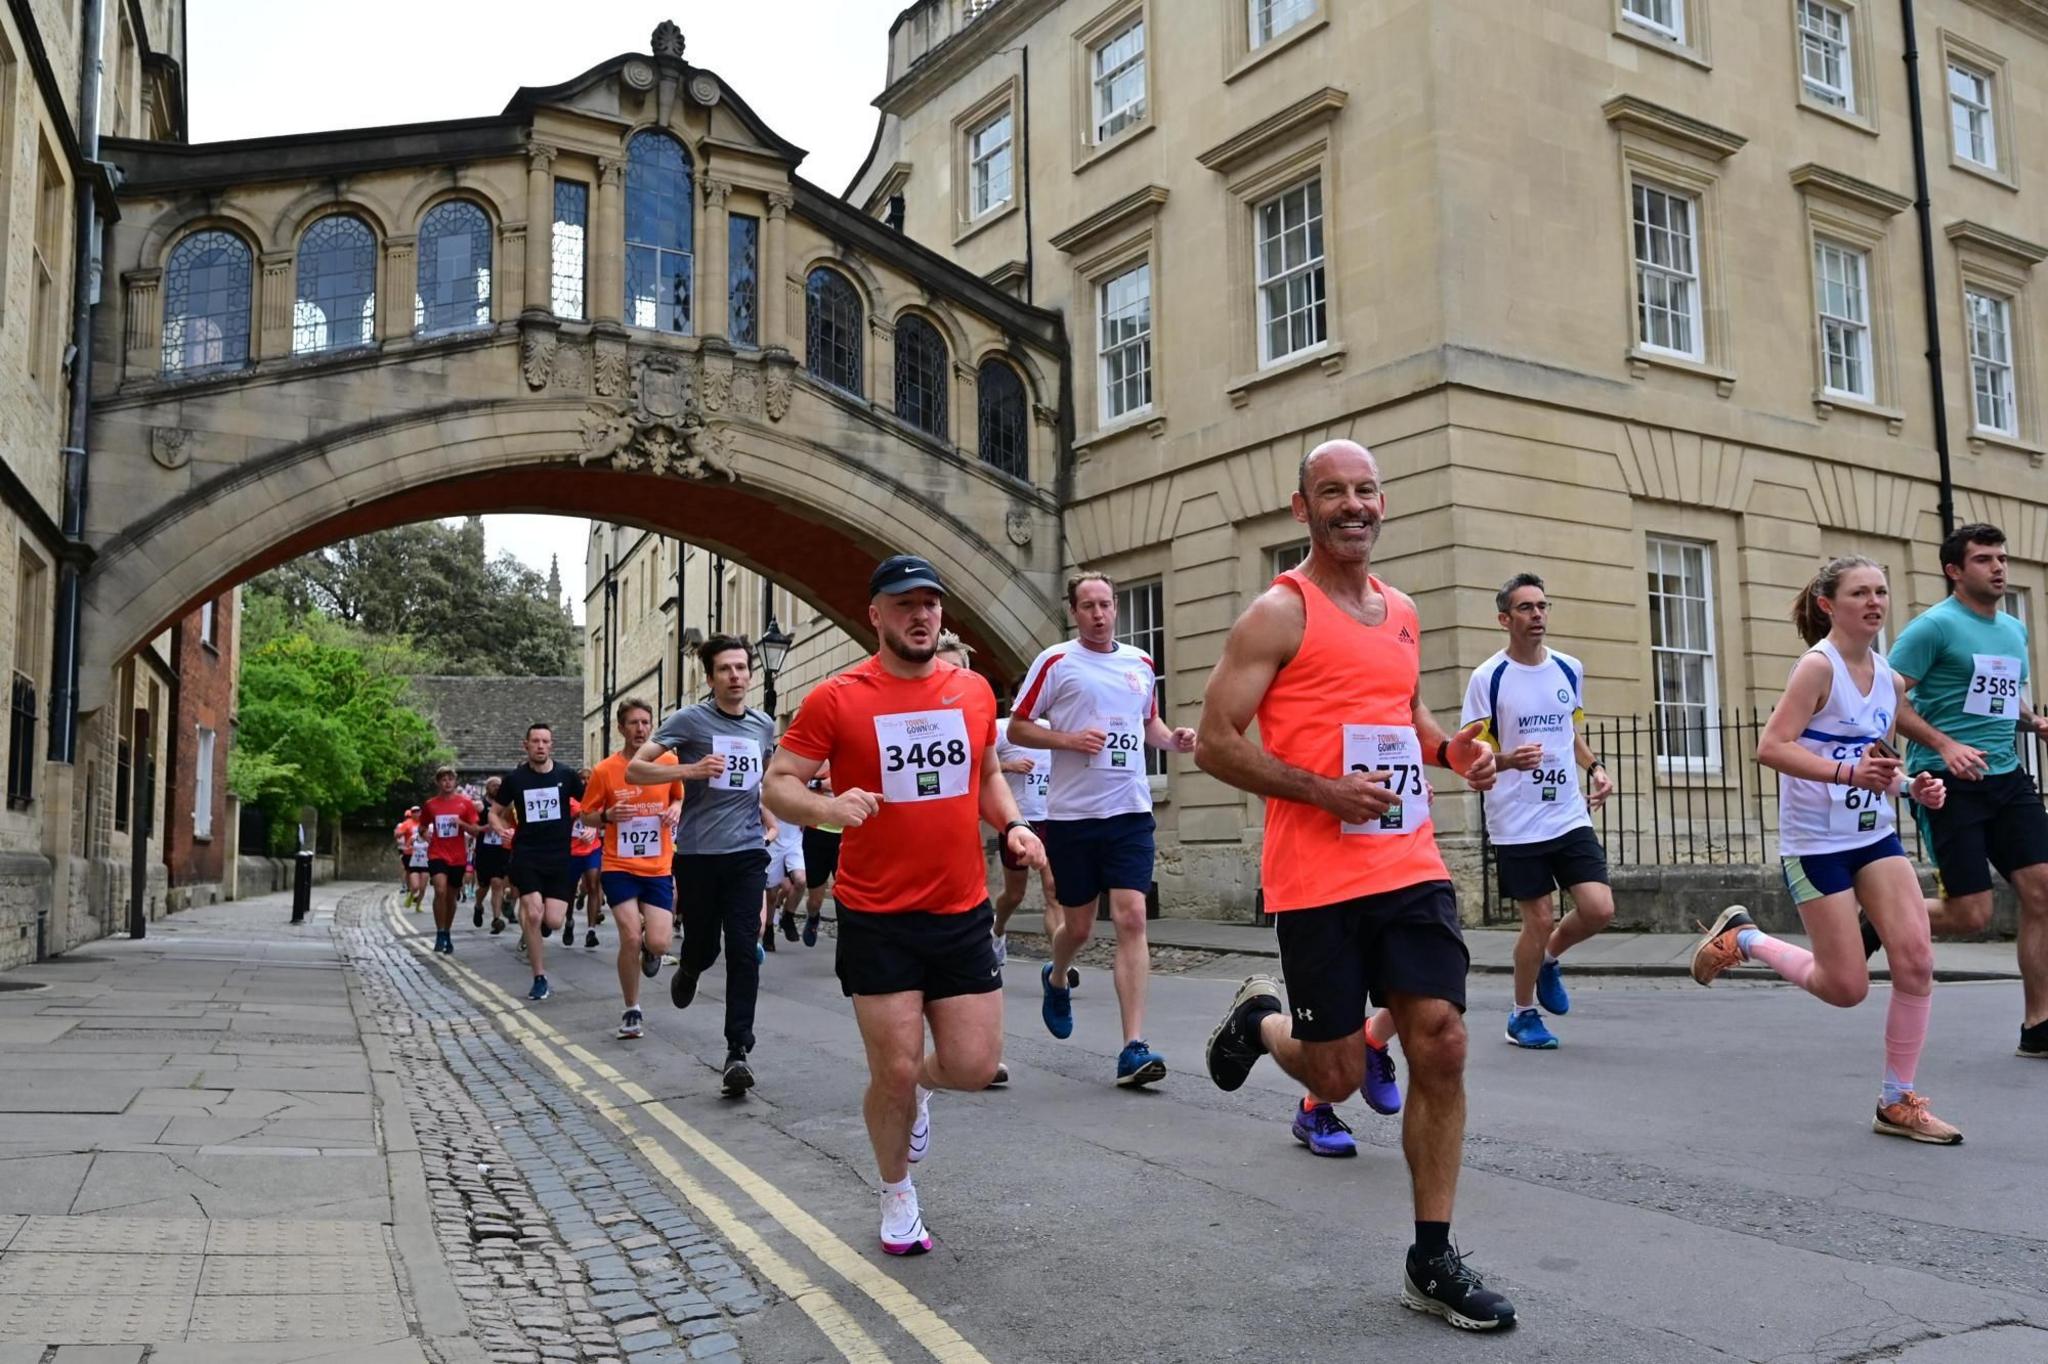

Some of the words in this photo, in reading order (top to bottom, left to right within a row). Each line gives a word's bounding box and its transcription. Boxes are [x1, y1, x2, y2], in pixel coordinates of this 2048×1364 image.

[1973, 675, 2017, 697] 3585
[1518, 714, 1565, 727] WITNEY
[1107, 732, 1138, 751] 262
[727, 755, 758, 773] 381
[886, 739, 966, 772] 3468
[1532, 768, 1567, 785] 946
[527, 798, 558, 811] 3179
[621, 830, 659, 844] 1072
